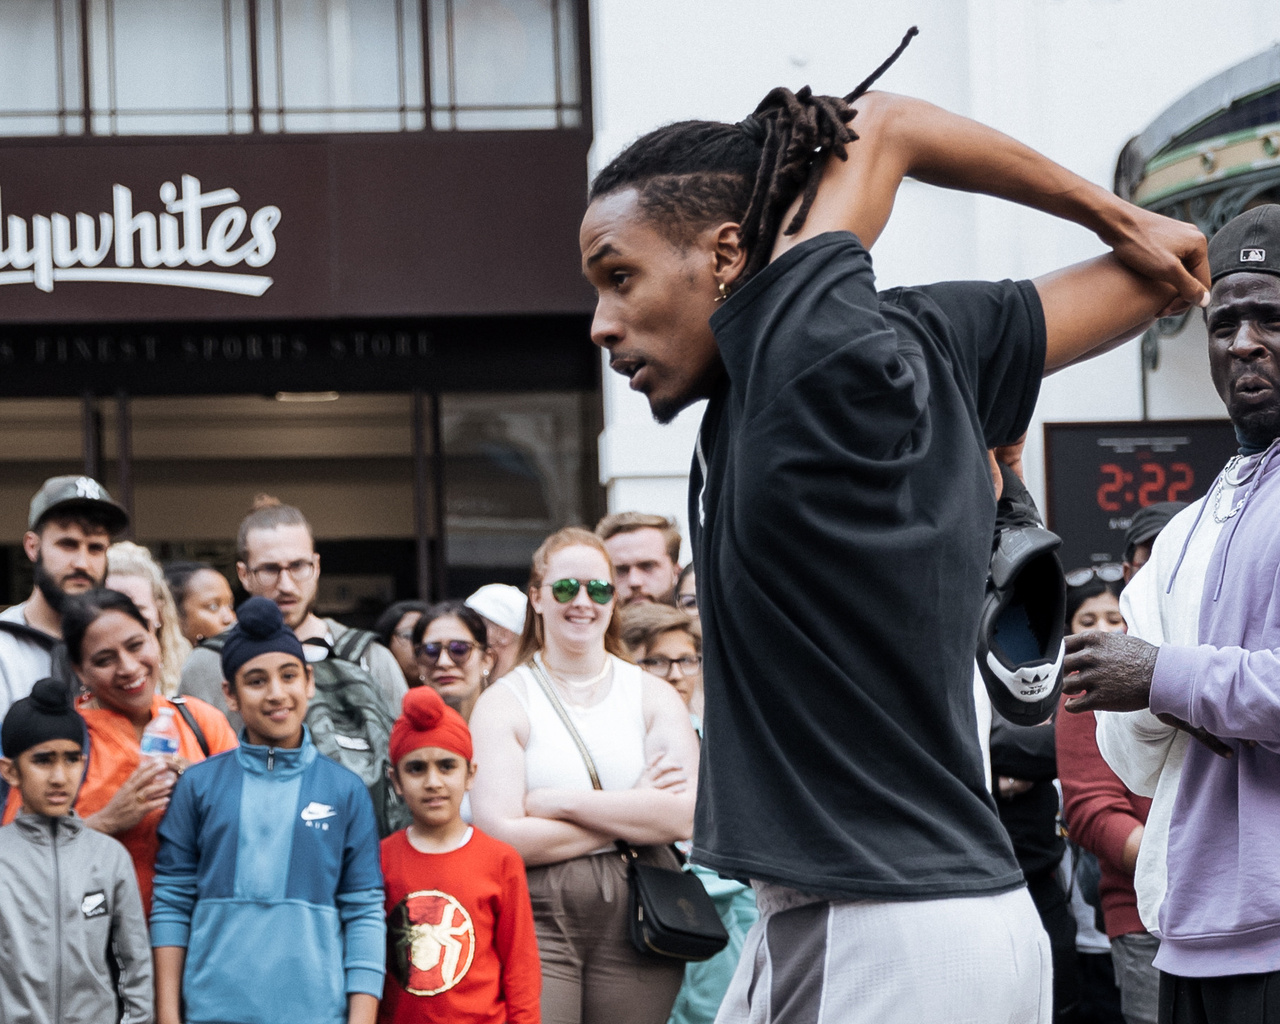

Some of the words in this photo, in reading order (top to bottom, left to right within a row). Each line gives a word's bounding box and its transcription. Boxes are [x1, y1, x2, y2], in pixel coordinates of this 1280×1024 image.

[0, 173, 282, 293] ywhites
[180, 332, 308, 362] SPORTS
[1096, 462, 1196, 512] 2:22
